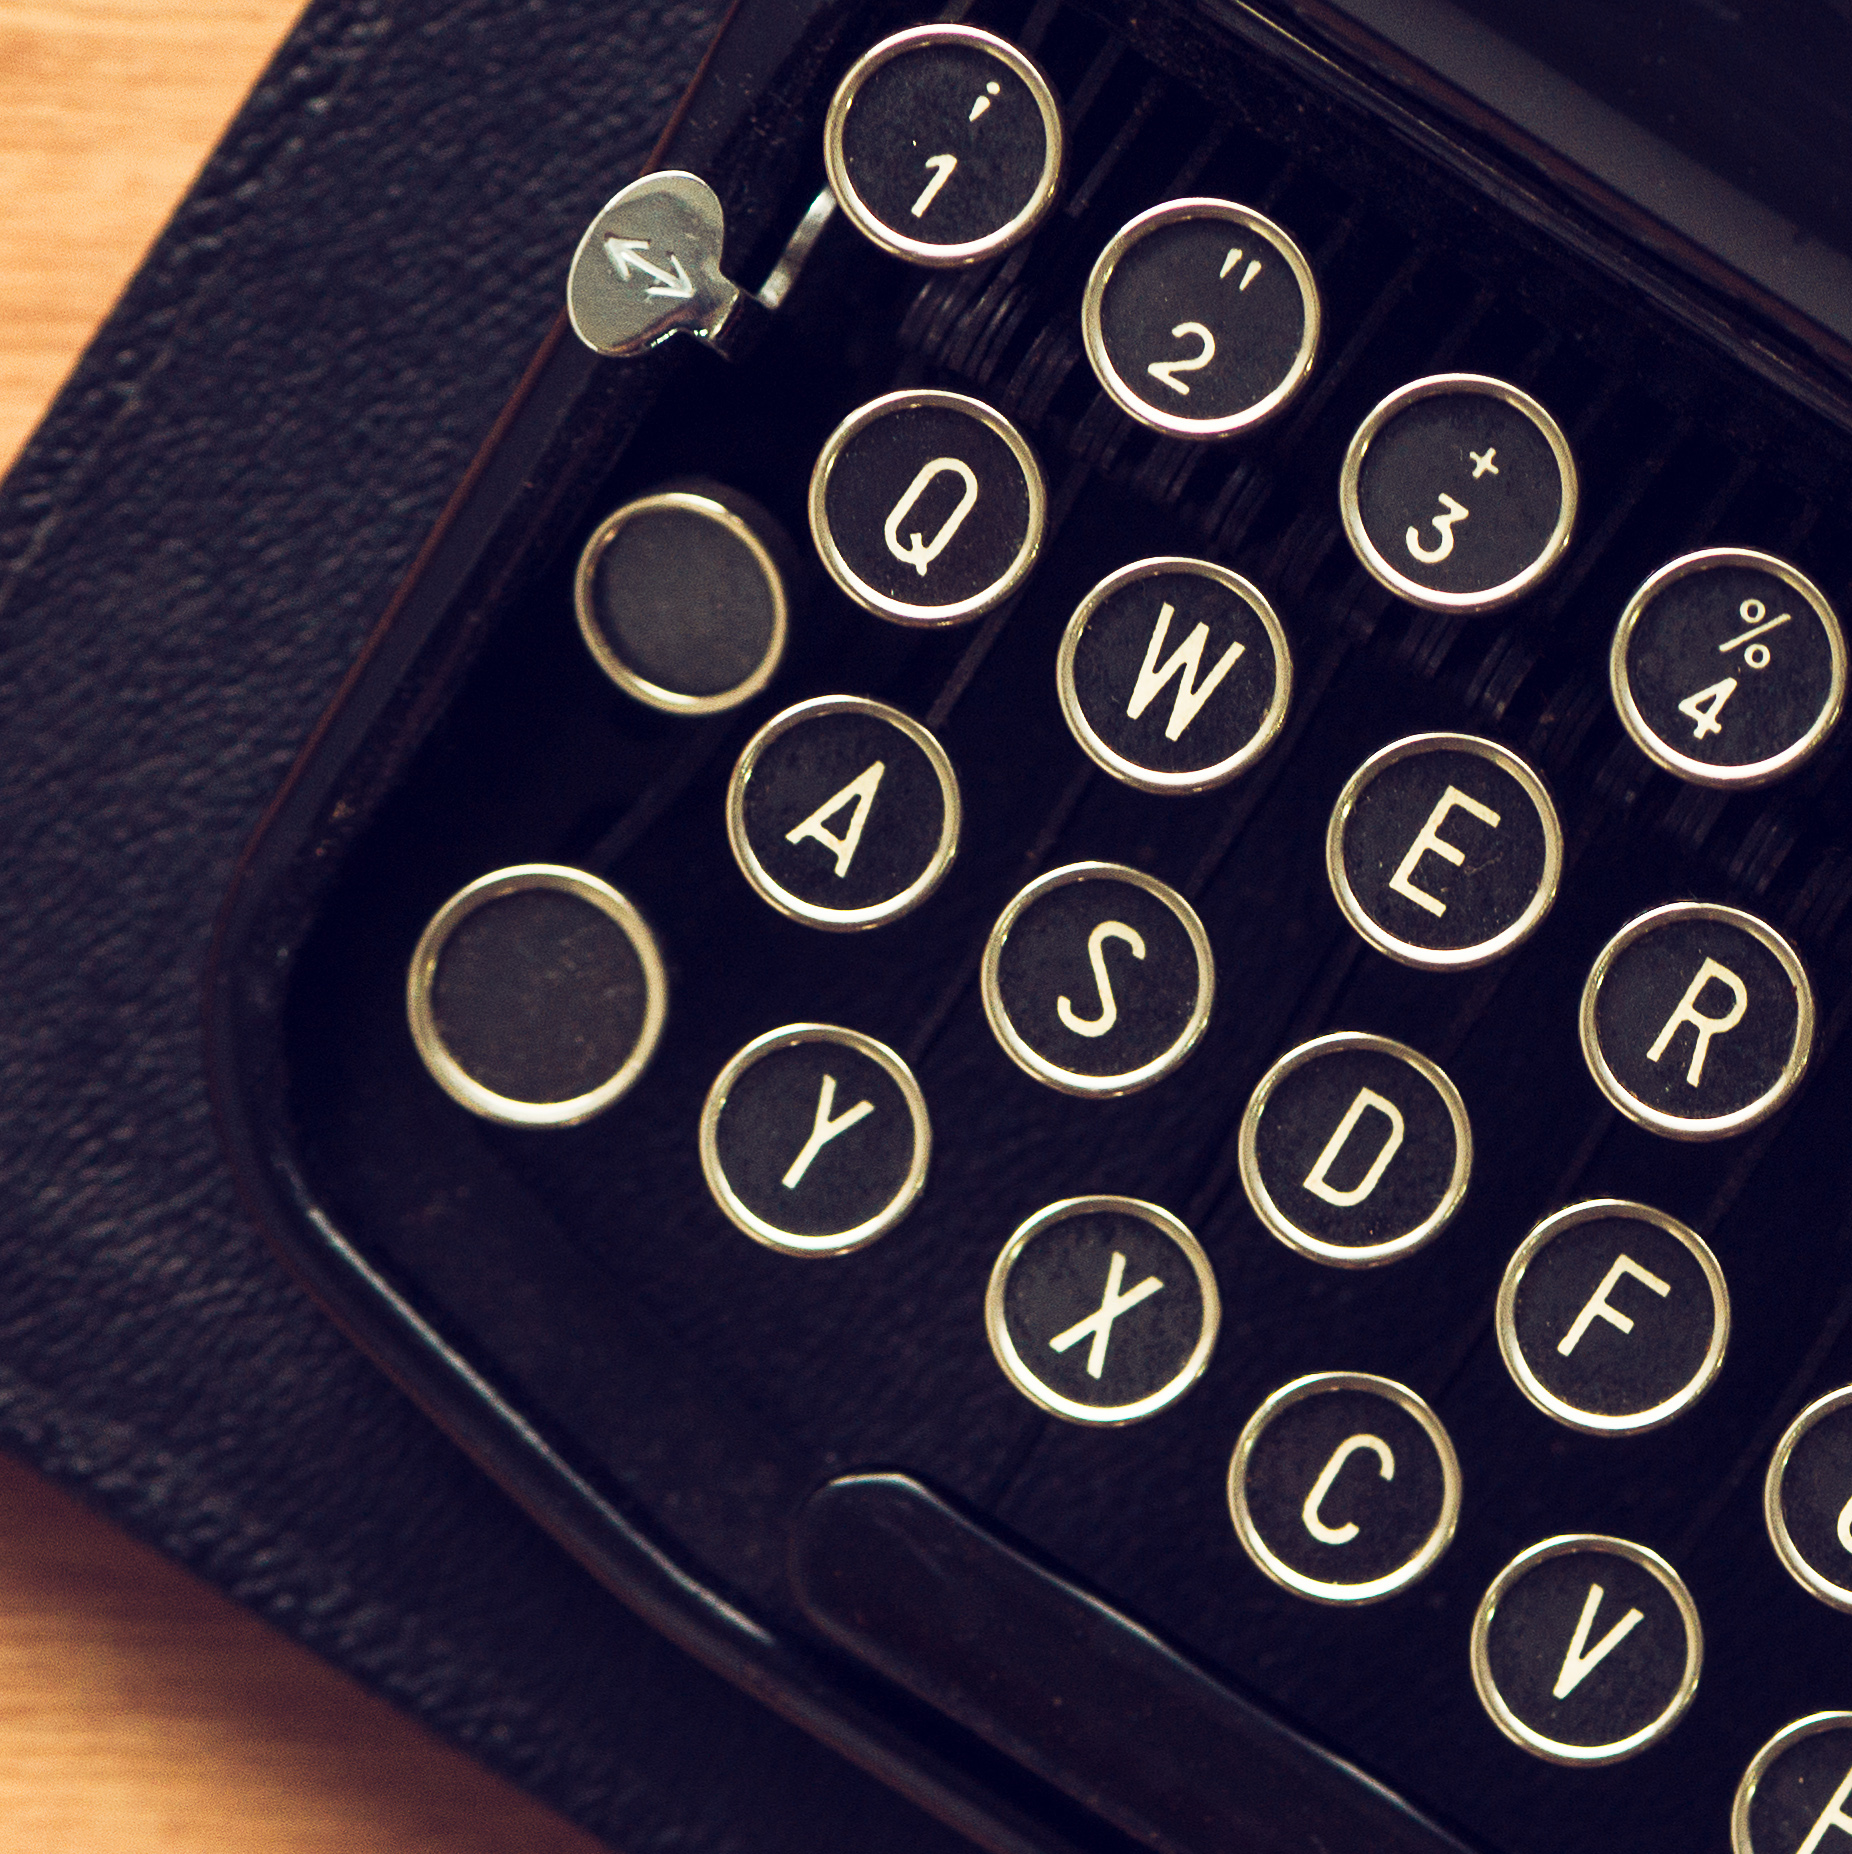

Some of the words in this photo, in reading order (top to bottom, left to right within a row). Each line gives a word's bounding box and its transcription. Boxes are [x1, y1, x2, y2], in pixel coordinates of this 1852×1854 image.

[909, 152, 959, 219] 1
[1146, 320, 1217, 397] 2
[882, 455, 980, 578] Q
[1468, 446, 1501, 480] +
[1404, 491, 1471, 566] 3
[1125, 600, 1247, 743] W
[1717, 597, 1793, 671] %
[1676, 675, 1739, 741] 4
[784, 759, 887, 880] A
[1387, 783, 1502, 919] E
[1055, 919, 1147, 1039] S
[1645, 955, 1749, 1089] R
[780, 1073, 876, 1191] Y
[1301, 1085, 1406, 1208] D
[1047, 1250, 1166, 1381] X
[1555, 1252, 1672, 1358] F
[1300, 1432, 1396, 1546] C
[1551, 1582, 1646, 1701] V
